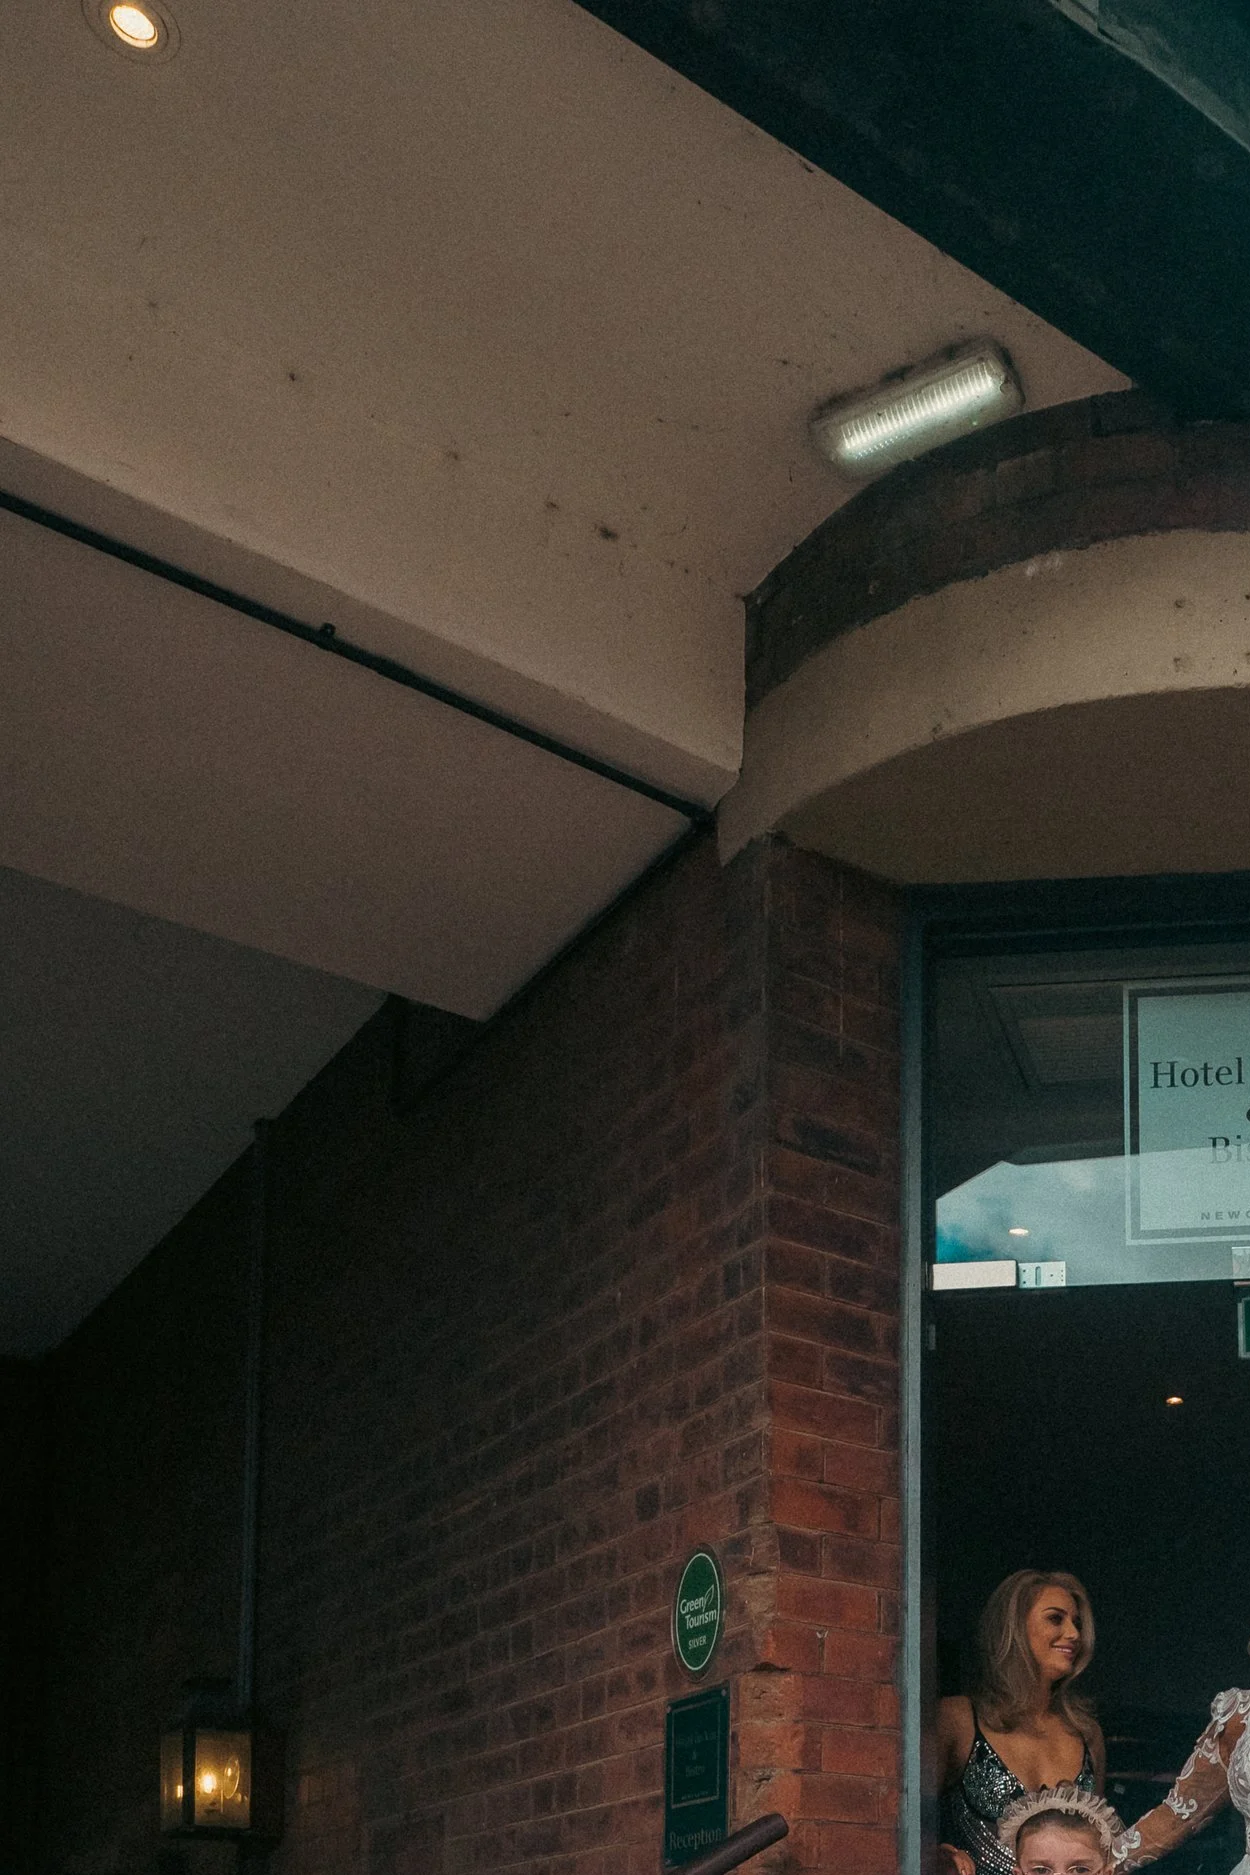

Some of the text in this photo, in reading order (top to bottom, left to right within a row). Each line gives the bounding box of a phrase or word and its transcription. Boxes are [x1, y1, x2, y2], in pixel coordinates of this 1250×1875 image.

[1150, 1056, 1245, 1089] Hotel
[680, 1596, 704, 1614] Green
[685, 1609, 717, 1630] Tourism
[688, 1635, 707, 1650] SILVER
[669, 1827, 722, 1851] Reception
